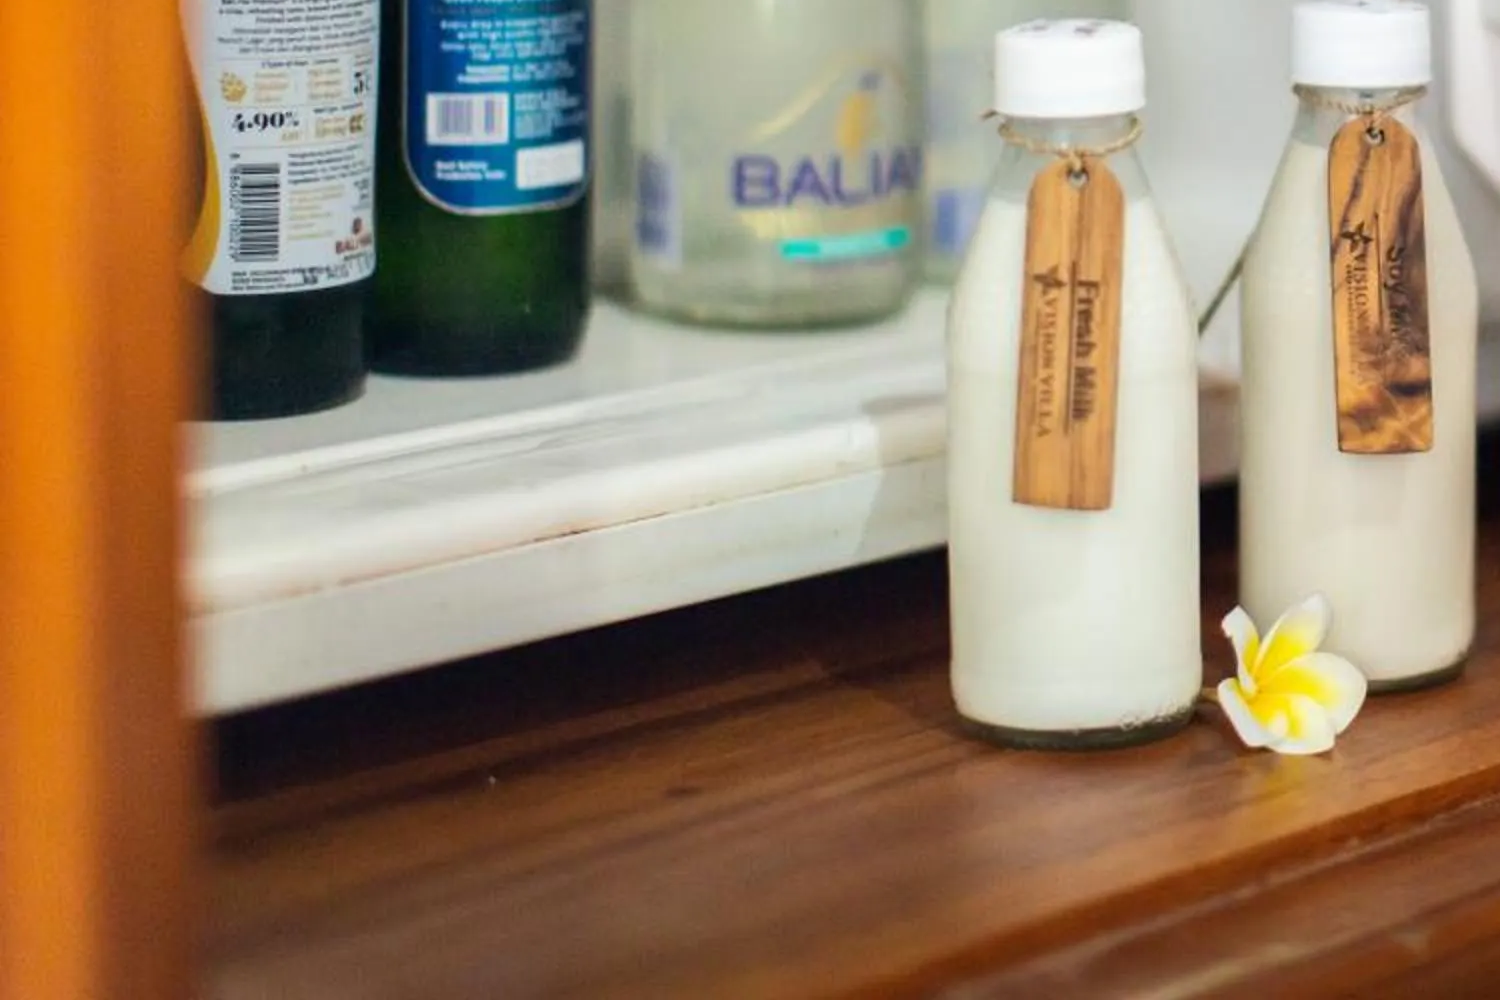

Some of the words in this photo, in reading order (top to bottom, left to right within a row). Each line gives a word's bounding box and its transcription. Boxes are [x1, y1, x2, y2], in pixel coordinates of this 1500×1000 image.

[231, 111, 300, 132] 4.90%
[1353, 254, 1370, 319] VISION
[1041, 297, 1057, 369] VISION
[1075, 280, 1100, 358] Fresh
[1037, 374, 1054, 437] VILLA
[1071, 367, 1097, 421] Milk
